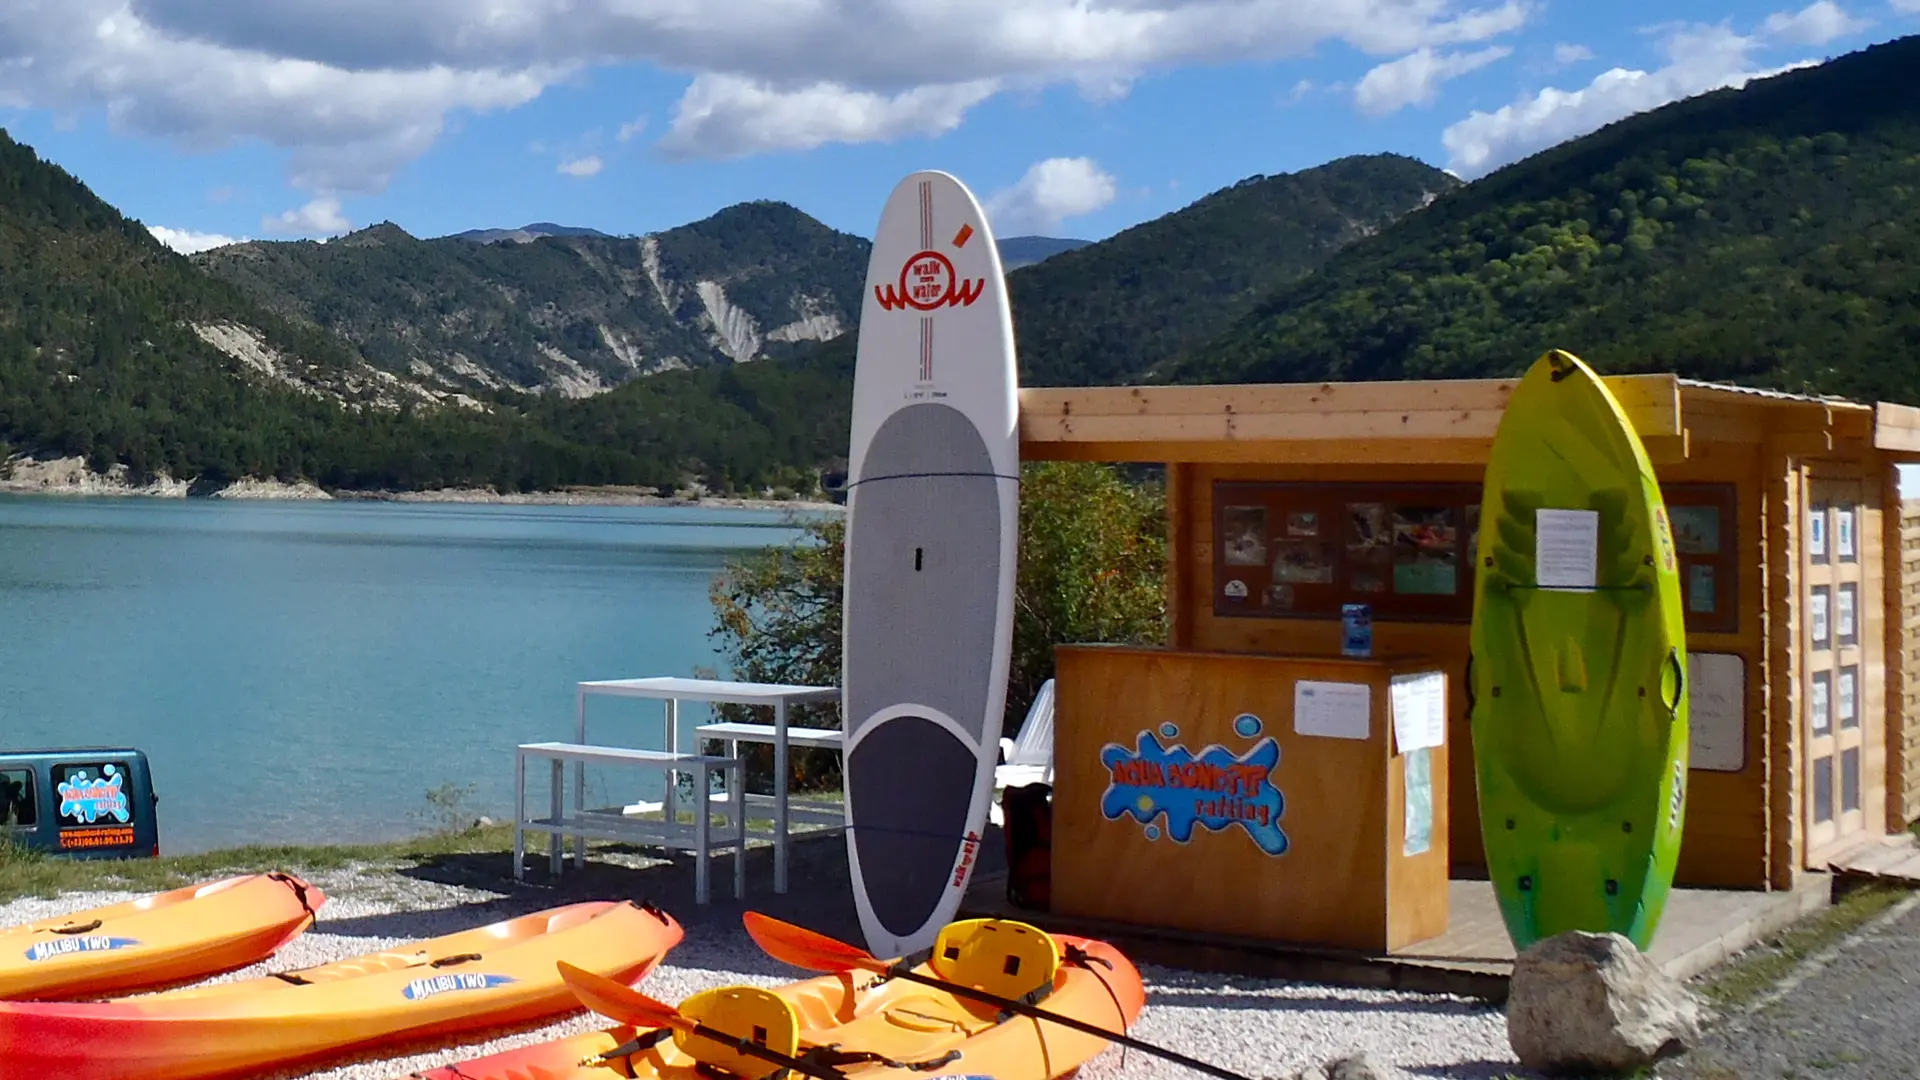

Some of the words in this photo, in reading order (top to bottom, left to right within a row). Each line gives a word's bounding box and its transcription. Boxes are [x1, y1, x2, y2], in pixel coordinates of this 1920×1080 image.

[1113, 760, 1165, 788] AQUA
[1195, 796, 1270, 826] rafting
[33, 937, 80, 960] MALIBU
[82, 936, 111, 950] TWO
[410, 975, 457, 999] MALIBU
[457, 973, 487, 990] TWO
